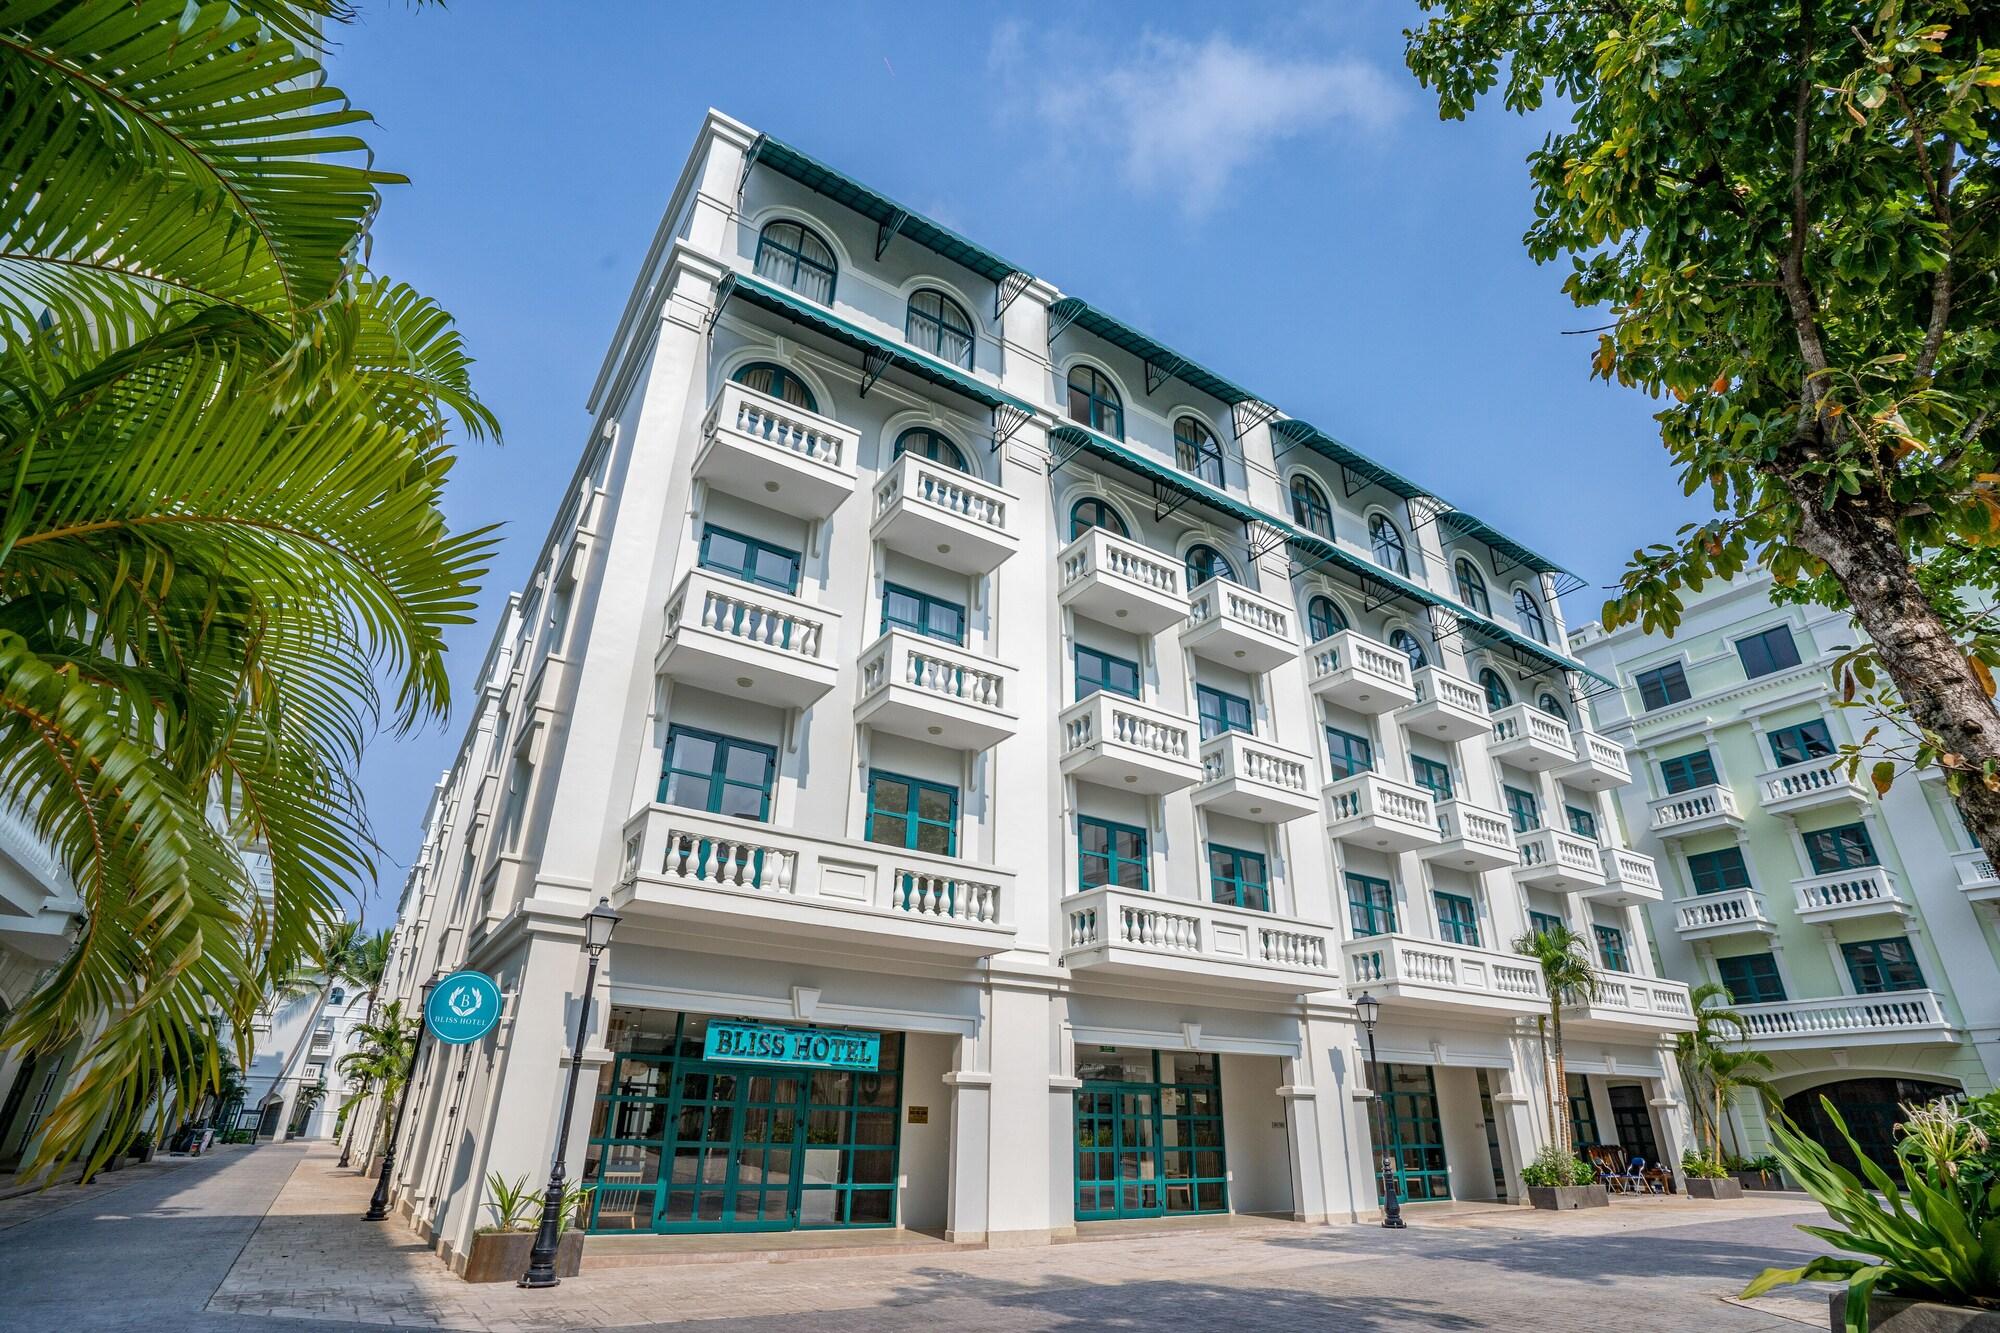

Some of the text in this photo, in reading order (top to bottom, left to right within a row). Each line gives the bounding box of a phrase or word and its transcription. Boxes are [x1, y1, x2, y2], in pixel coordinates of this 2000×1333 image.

[461, 994, 470, 1008] B
[434, 1015, 486, 1026] BLISS HOTEL
[715, 1029, 872, 1063] BLISS HOTEL
